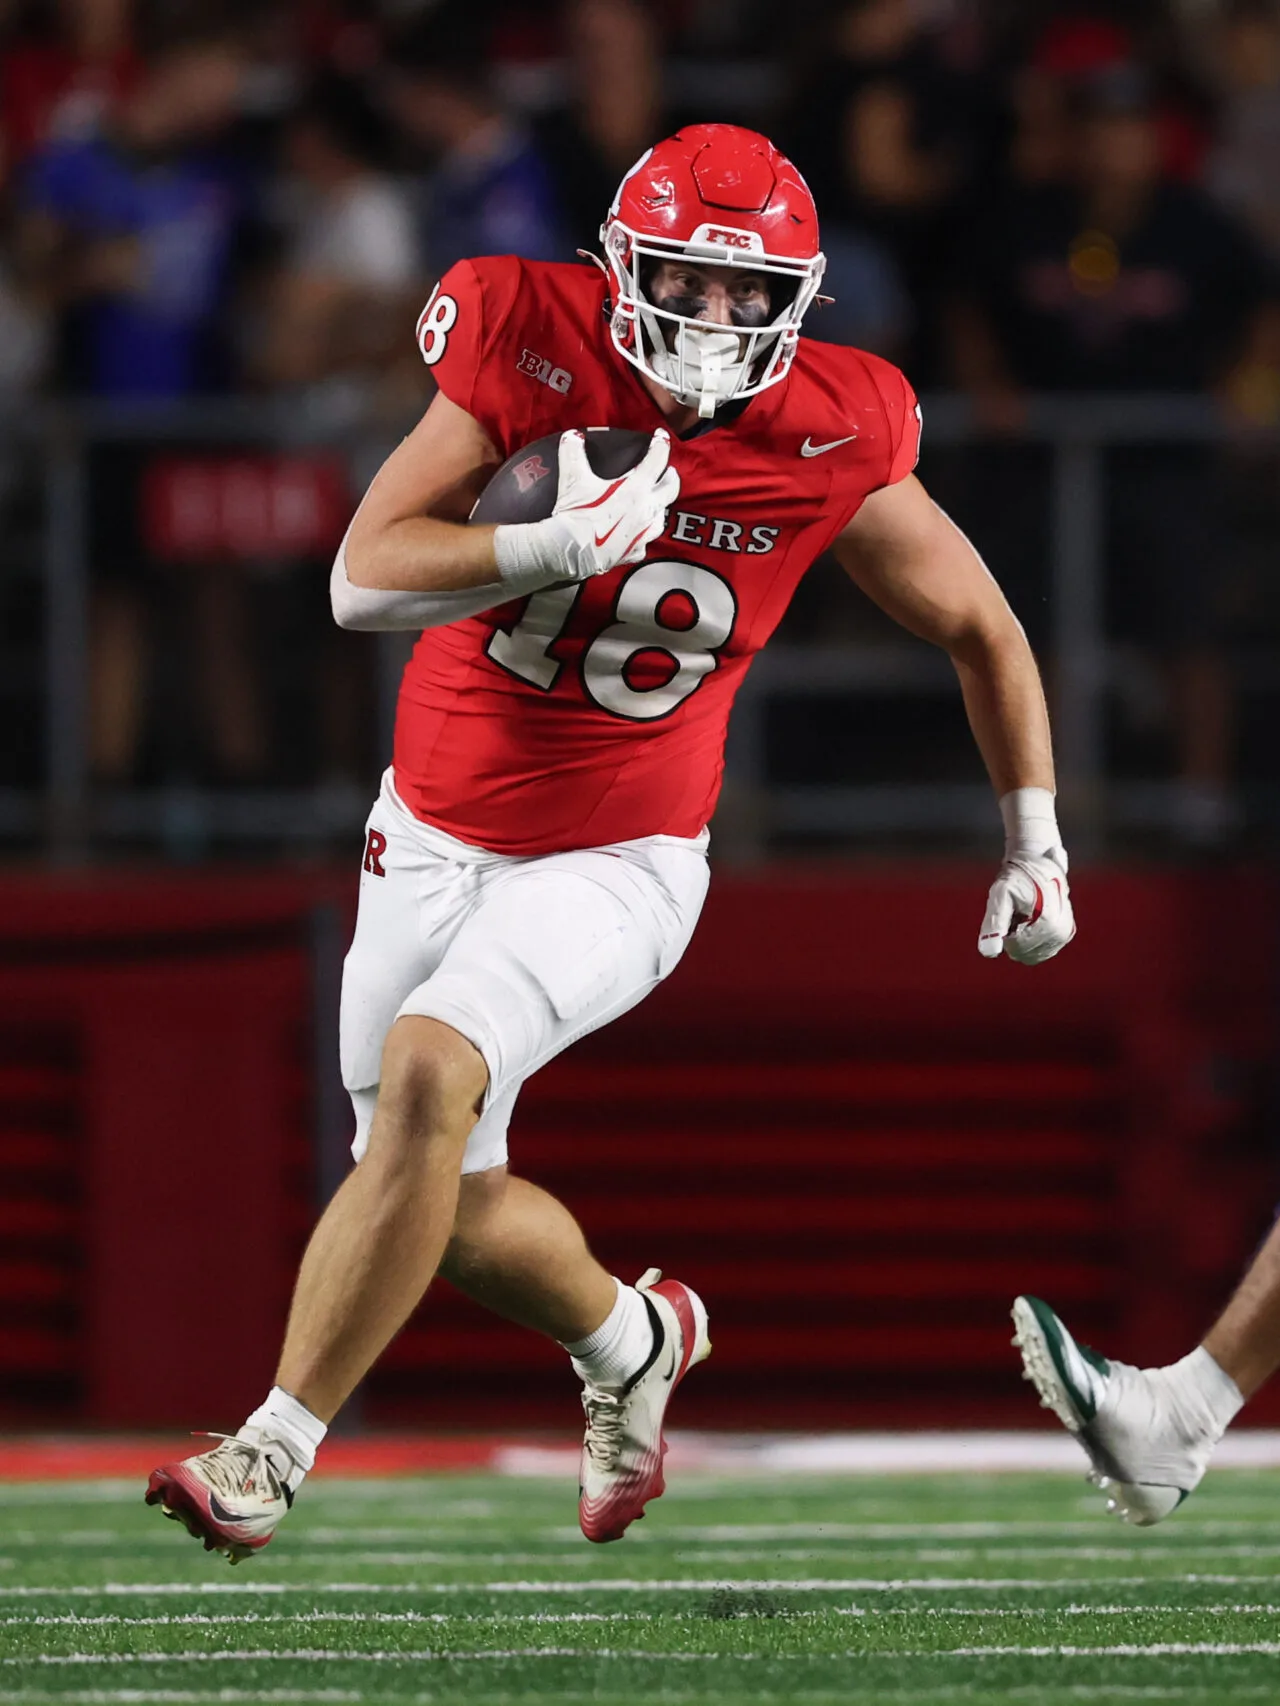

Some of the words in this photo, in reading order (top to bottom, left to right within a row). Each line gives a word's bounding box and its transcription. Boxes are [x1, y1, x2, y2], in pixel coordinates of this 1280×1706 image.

[511, 454, 550, 492] R
[664, 508, 779, 553] ERS
[484, 558, 739, 722] 18
[363, 827, 387, 878] R
